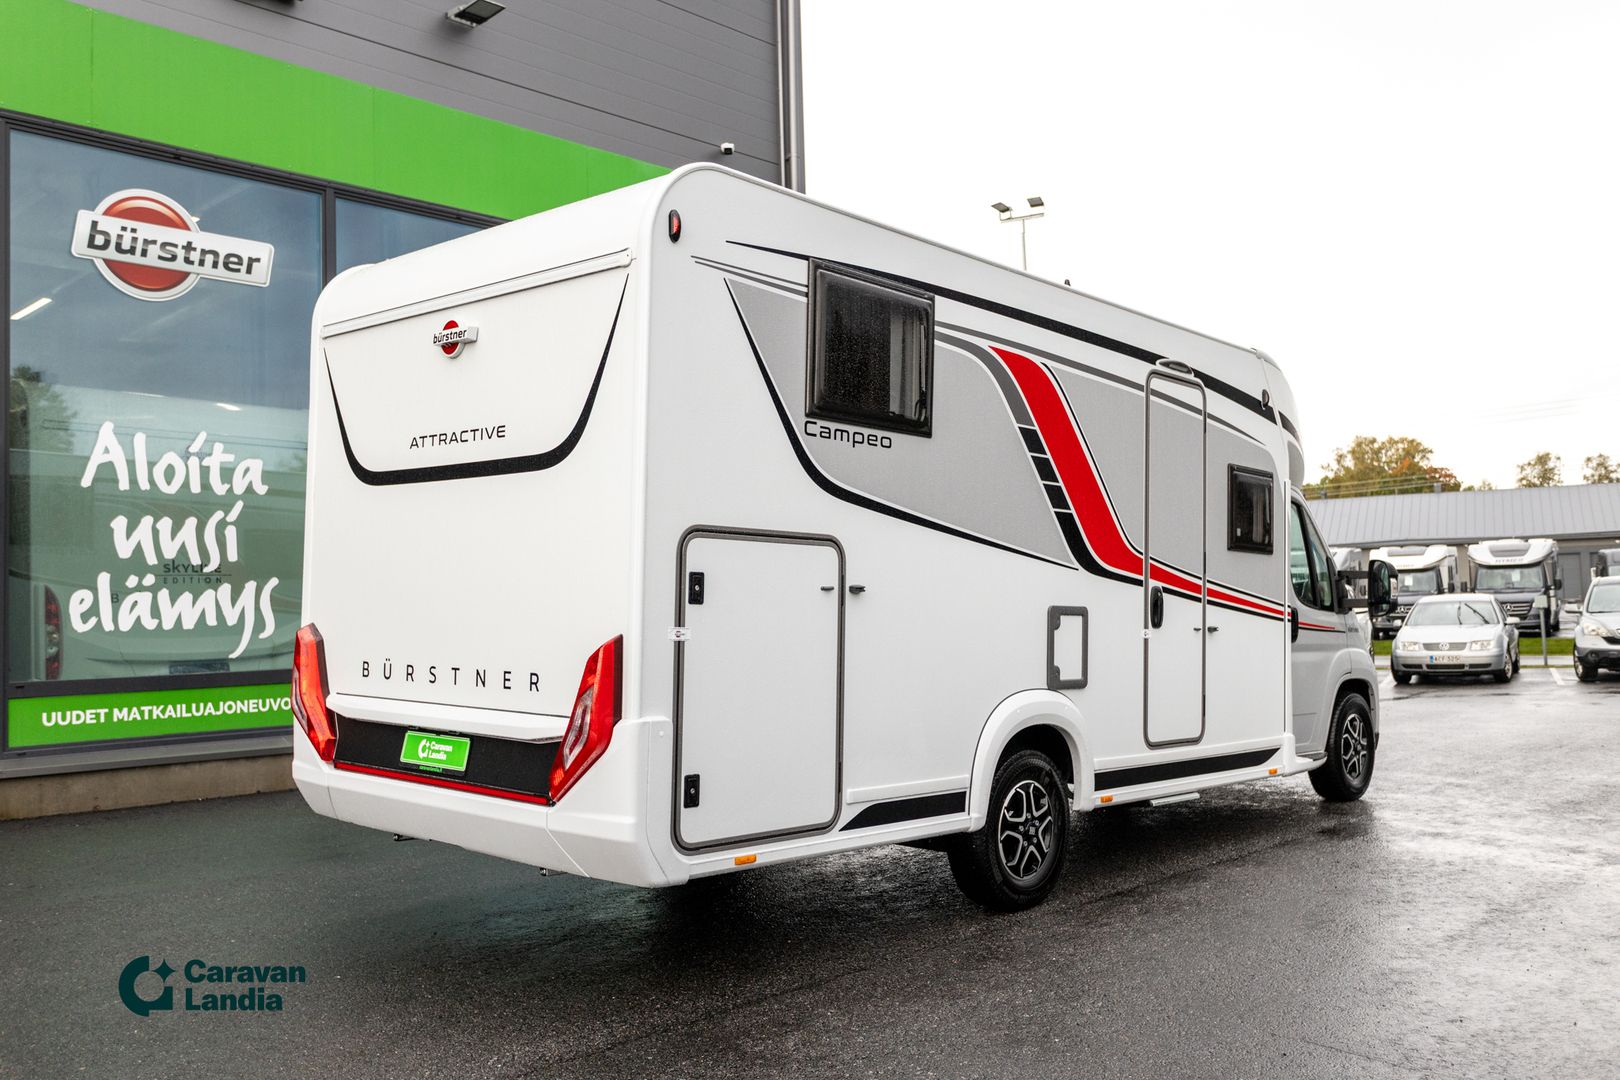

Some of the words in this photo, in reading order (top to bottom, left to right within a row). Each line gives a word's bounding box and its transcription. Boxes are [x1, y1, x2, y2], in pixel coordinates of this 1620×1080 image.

[86, 220, 261, 275] bürstner
[432, 329, 468, 344] bürstner
[409, 425, 507, 449] ATTRACTIVE
[804, 420, 892, 449] Campeo
[80, 420, 269, 496] Aloita
[110, 500, 244, 573] uusi
[163, 576, 223, 585] EDITION
[69, 571, 279, 659] elämys
[361, 658, 541, 692] BÜRSTNER
[41, 708, 109, 727] UUDET
[430, 741, 453, 752] Caravan
